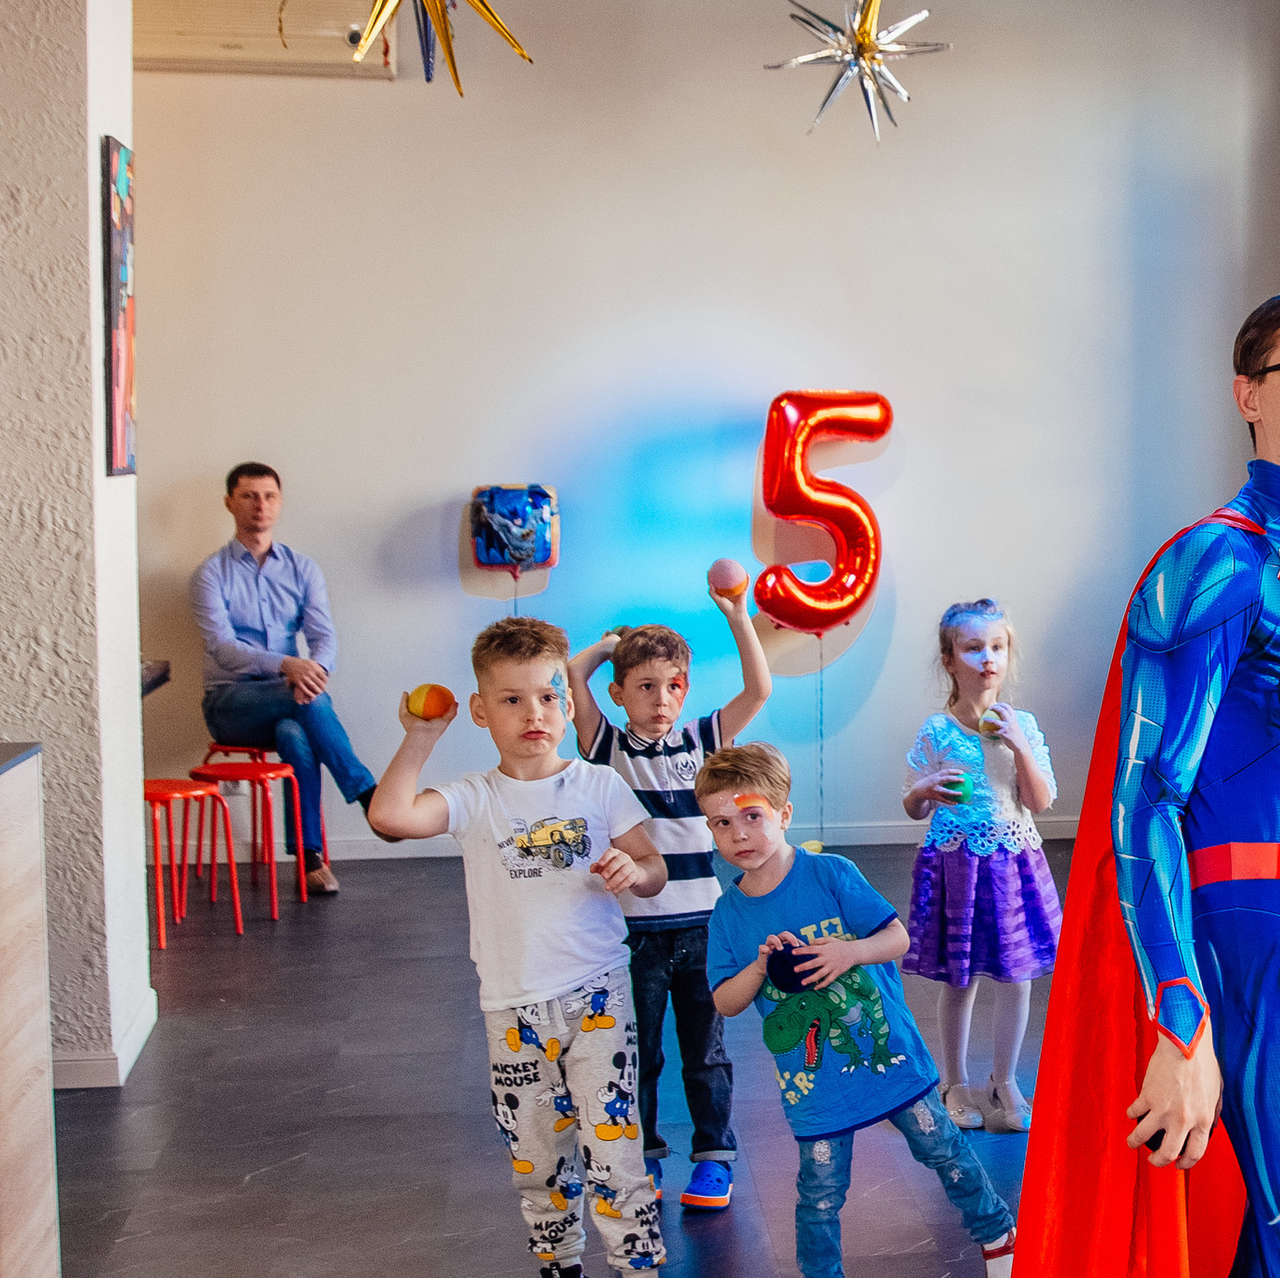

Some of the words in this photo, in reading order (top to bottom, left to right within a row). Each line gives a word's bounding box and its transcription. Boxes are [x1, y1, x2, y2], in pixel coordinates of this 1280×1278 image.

[754, 389, 894, 633] 5
[497, 836, 515, 849] NEVER
[509, 867, 543, 879] EXPLORE
[492, 1059, 540, 1075] MICKEY
[494, 1072, 541, 1088] MOUSE
